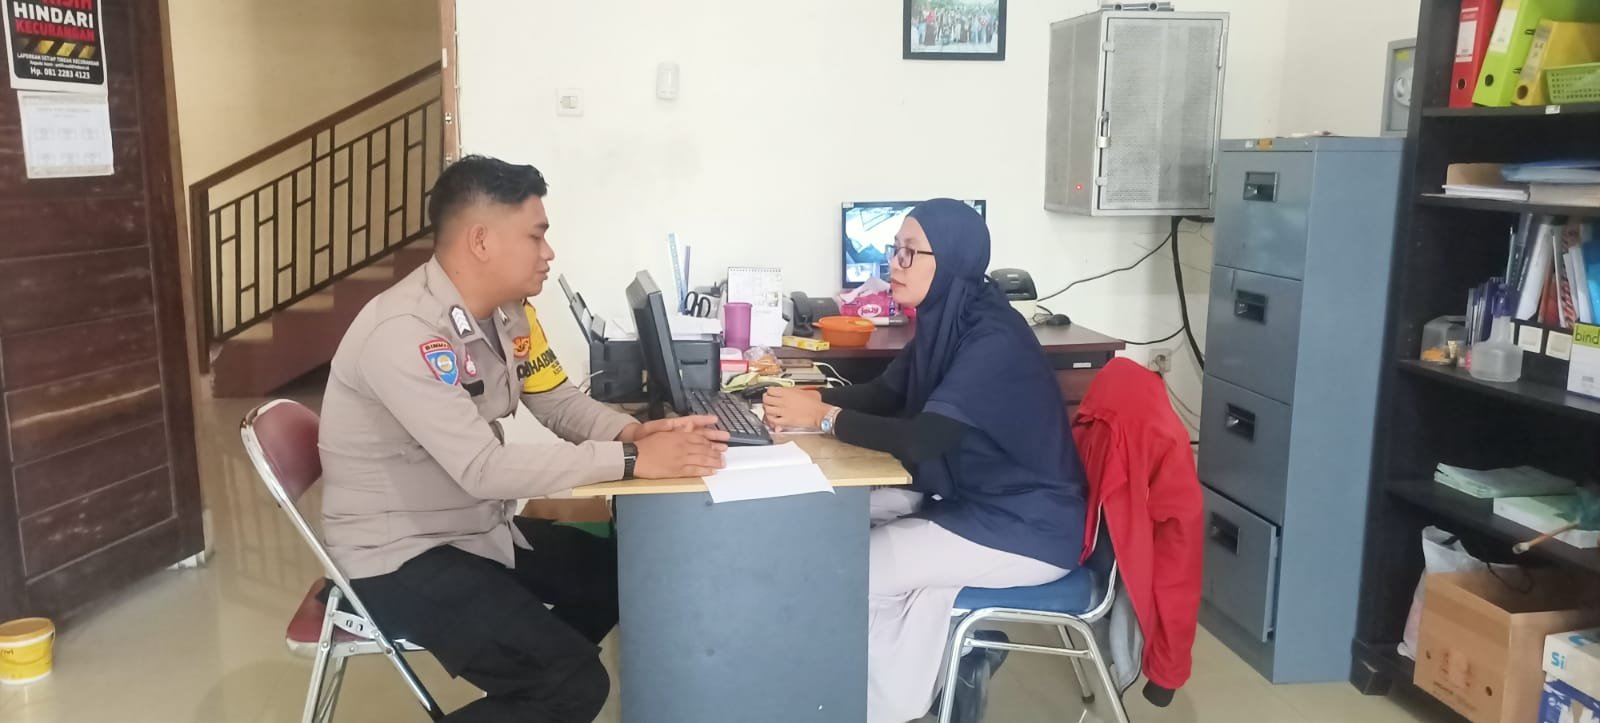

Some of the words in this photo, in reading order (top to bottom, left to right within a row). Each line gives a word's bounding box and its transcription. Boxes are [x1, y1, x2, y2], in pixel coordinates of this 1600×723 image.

[13, 1, 94, 28] HINDARI
[15, 19, 95, 41] KECURANGAN
[44, 68, 56, 76] 081
[1551, 651, 1565, 670] Si
